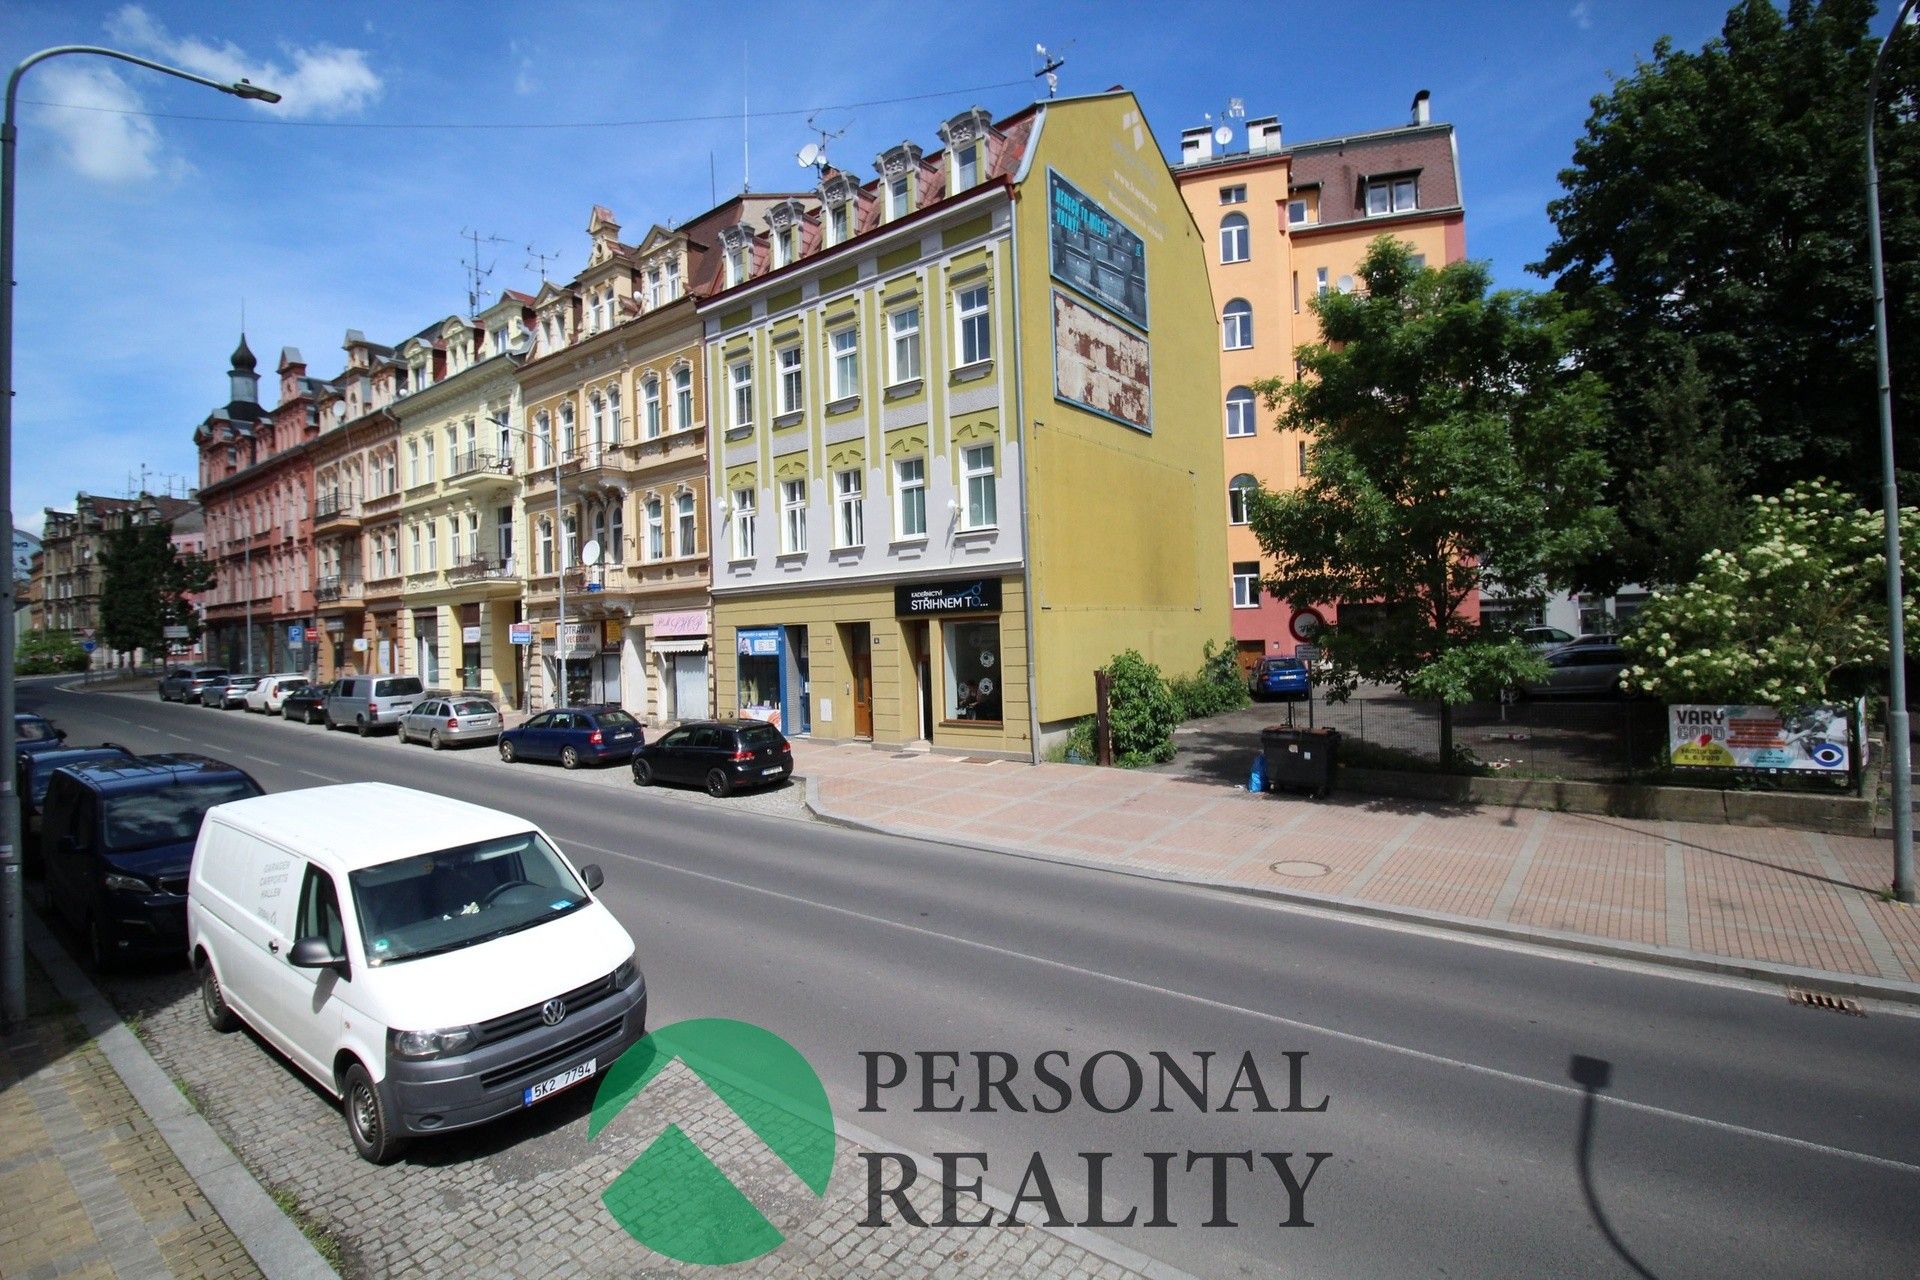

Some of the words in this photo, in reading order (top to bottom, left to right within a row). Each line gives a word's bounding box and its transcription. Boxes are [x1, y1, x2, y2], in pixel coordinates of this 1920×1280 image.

[911, 597, 962, 610] STŘIHNEM
[562, 624, 597, 635] OTRAVINY
[1676, 710, 1725, 725] VARY
[1677, 725, 1726, 740] GOOD
[534, 1079, 556, 1097] 5K2
[564, 1062, 591, 1084] 7794
